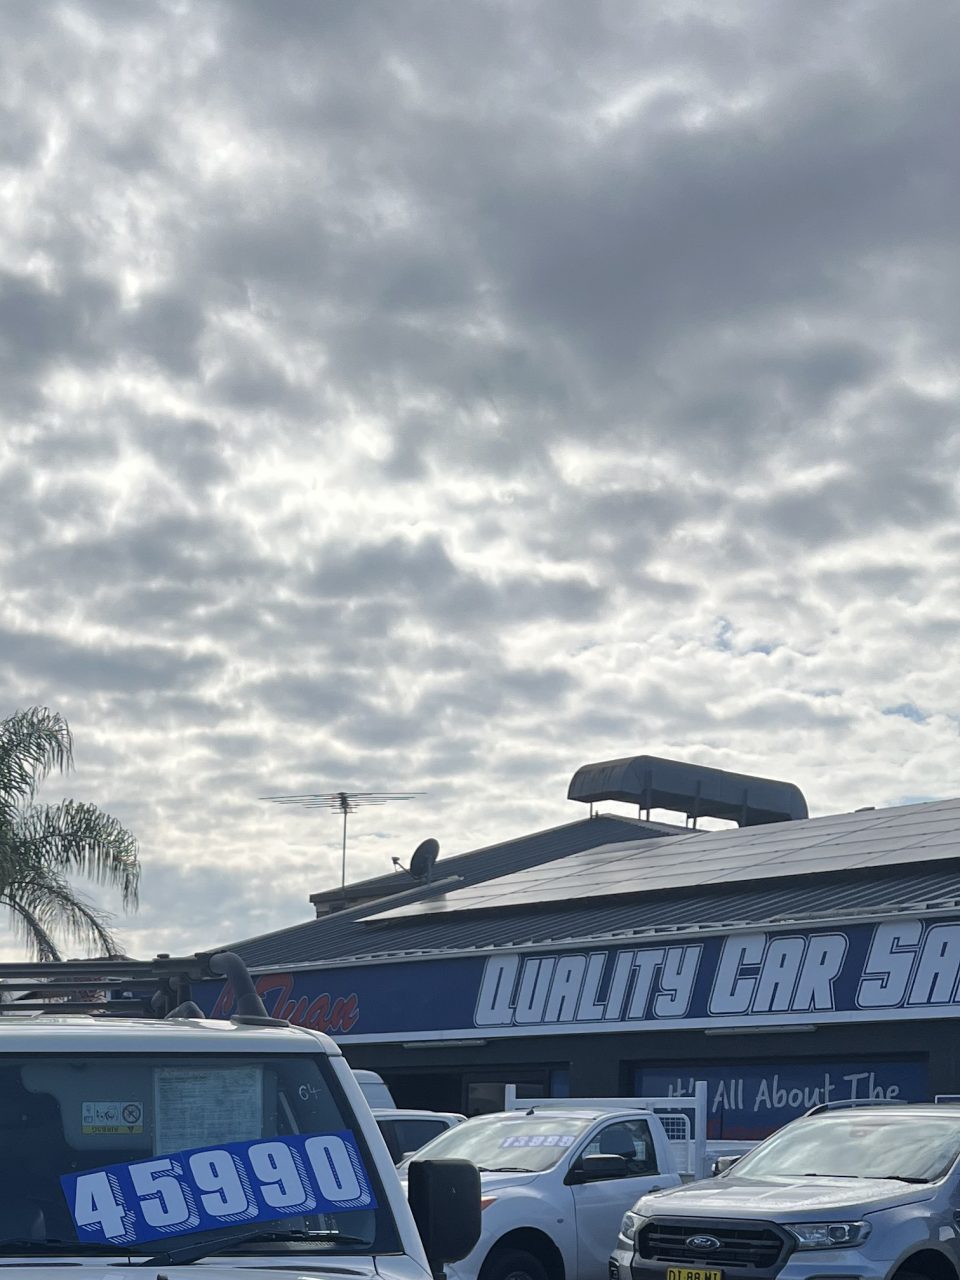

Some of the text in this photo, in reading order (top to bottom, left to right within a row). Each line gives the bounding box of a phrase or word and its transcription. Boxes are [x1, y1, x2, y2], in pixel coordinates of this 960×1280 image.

[474, 944, 704, 1027] QUALITY
[707, 932, 849, 1016] CAR
[854, 918, 960, 1010] SA
[298, 1083, 322, 1101] 64
[712, 1079, 744, 1113] All
[754, 1073, 835, 1112] About
[842, 1072, 901, 1106] The
[74, 1136, 371, 1243] 45990
